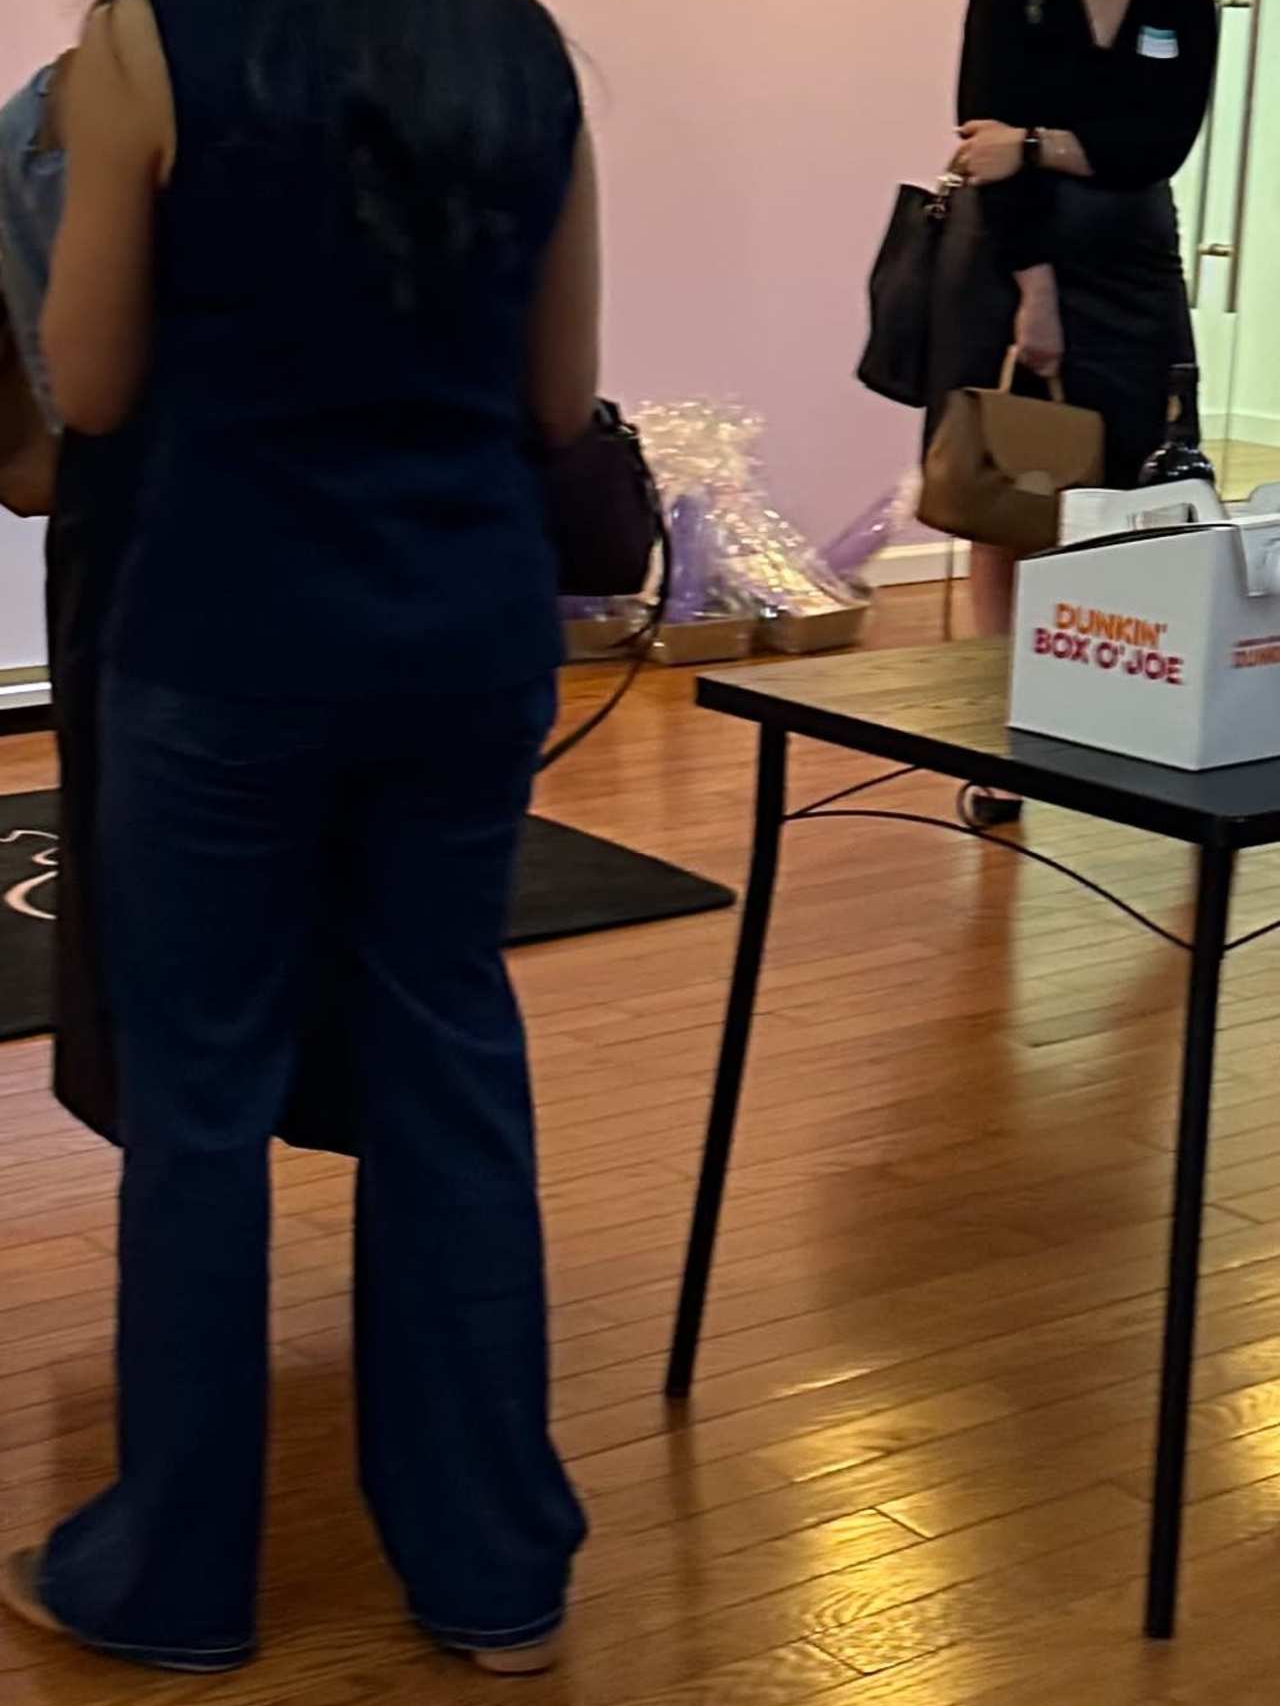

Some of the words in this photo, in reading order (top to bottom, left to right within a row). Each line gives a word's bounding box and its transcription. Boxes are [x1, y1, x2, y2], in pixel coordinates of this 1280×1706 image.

[1055, 602, 1168, 647] DUNKIN'
[1034, 628, 1091, 665] BOX
[1124, 649, 1185, 685] JOE
